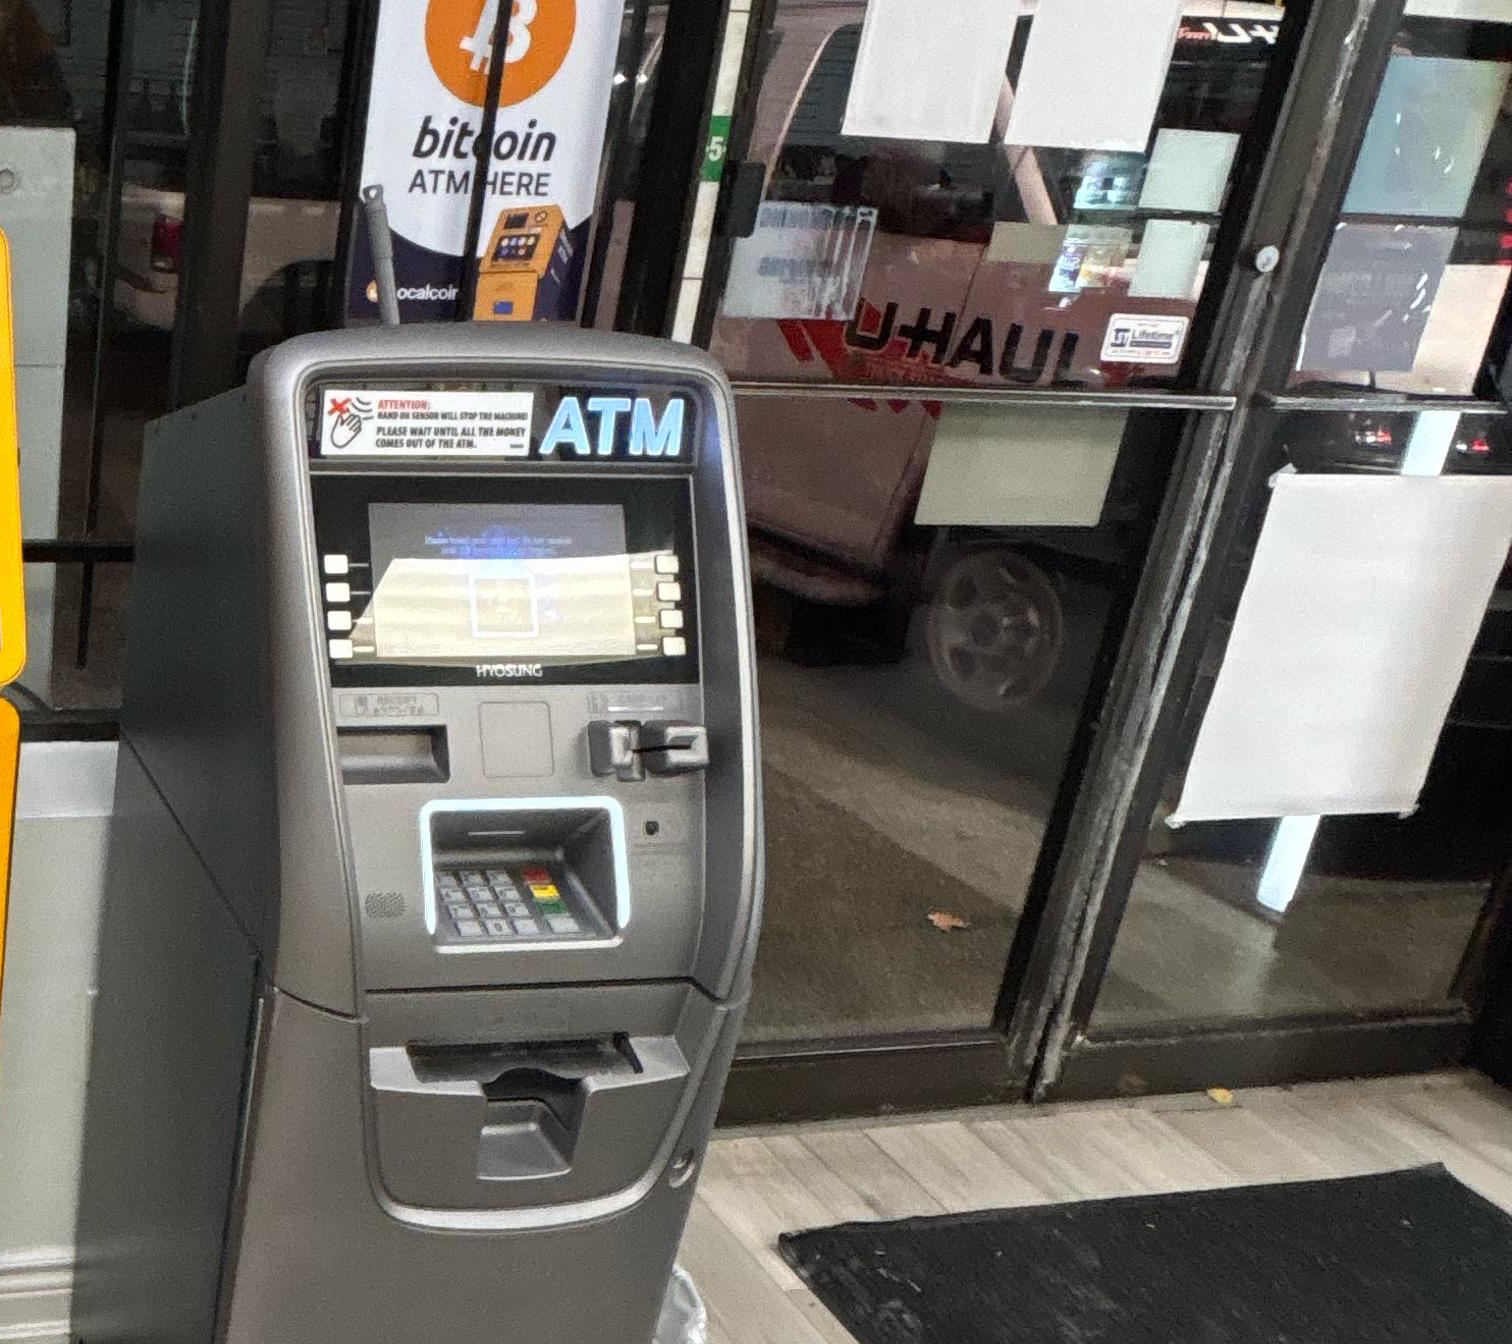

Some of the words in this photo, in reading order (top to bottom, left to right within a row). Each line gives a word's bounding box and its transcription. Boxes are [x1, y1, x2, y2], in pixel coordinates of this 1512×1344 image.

[408, 169, 471, 195] ATM
[845, 297, 1087, 387] U-HAUL
[441, 412, 458, 420] WILL
[459, 412, 478, 420] STOP
[479, 412, 493, 420] THE
[376, 427, 407, 436] PLEASE
[410, 427, 431, 436] WAIT
[434, 427, 459, 436] UNTIL
[461, 427, 476, 437] ALL
[478, 427, 494, 437] THE
[496, 427, 525, 437] MONEY
[539, 395, 685, 455] ATM
[375, 438, 404, 448] COMES
[406, 439, 423, 448] OUT
[425, 439, 435, 448] OF
[438, 439, 454, 448] THE
[475, 663, 544, 678] HYOSUNG
